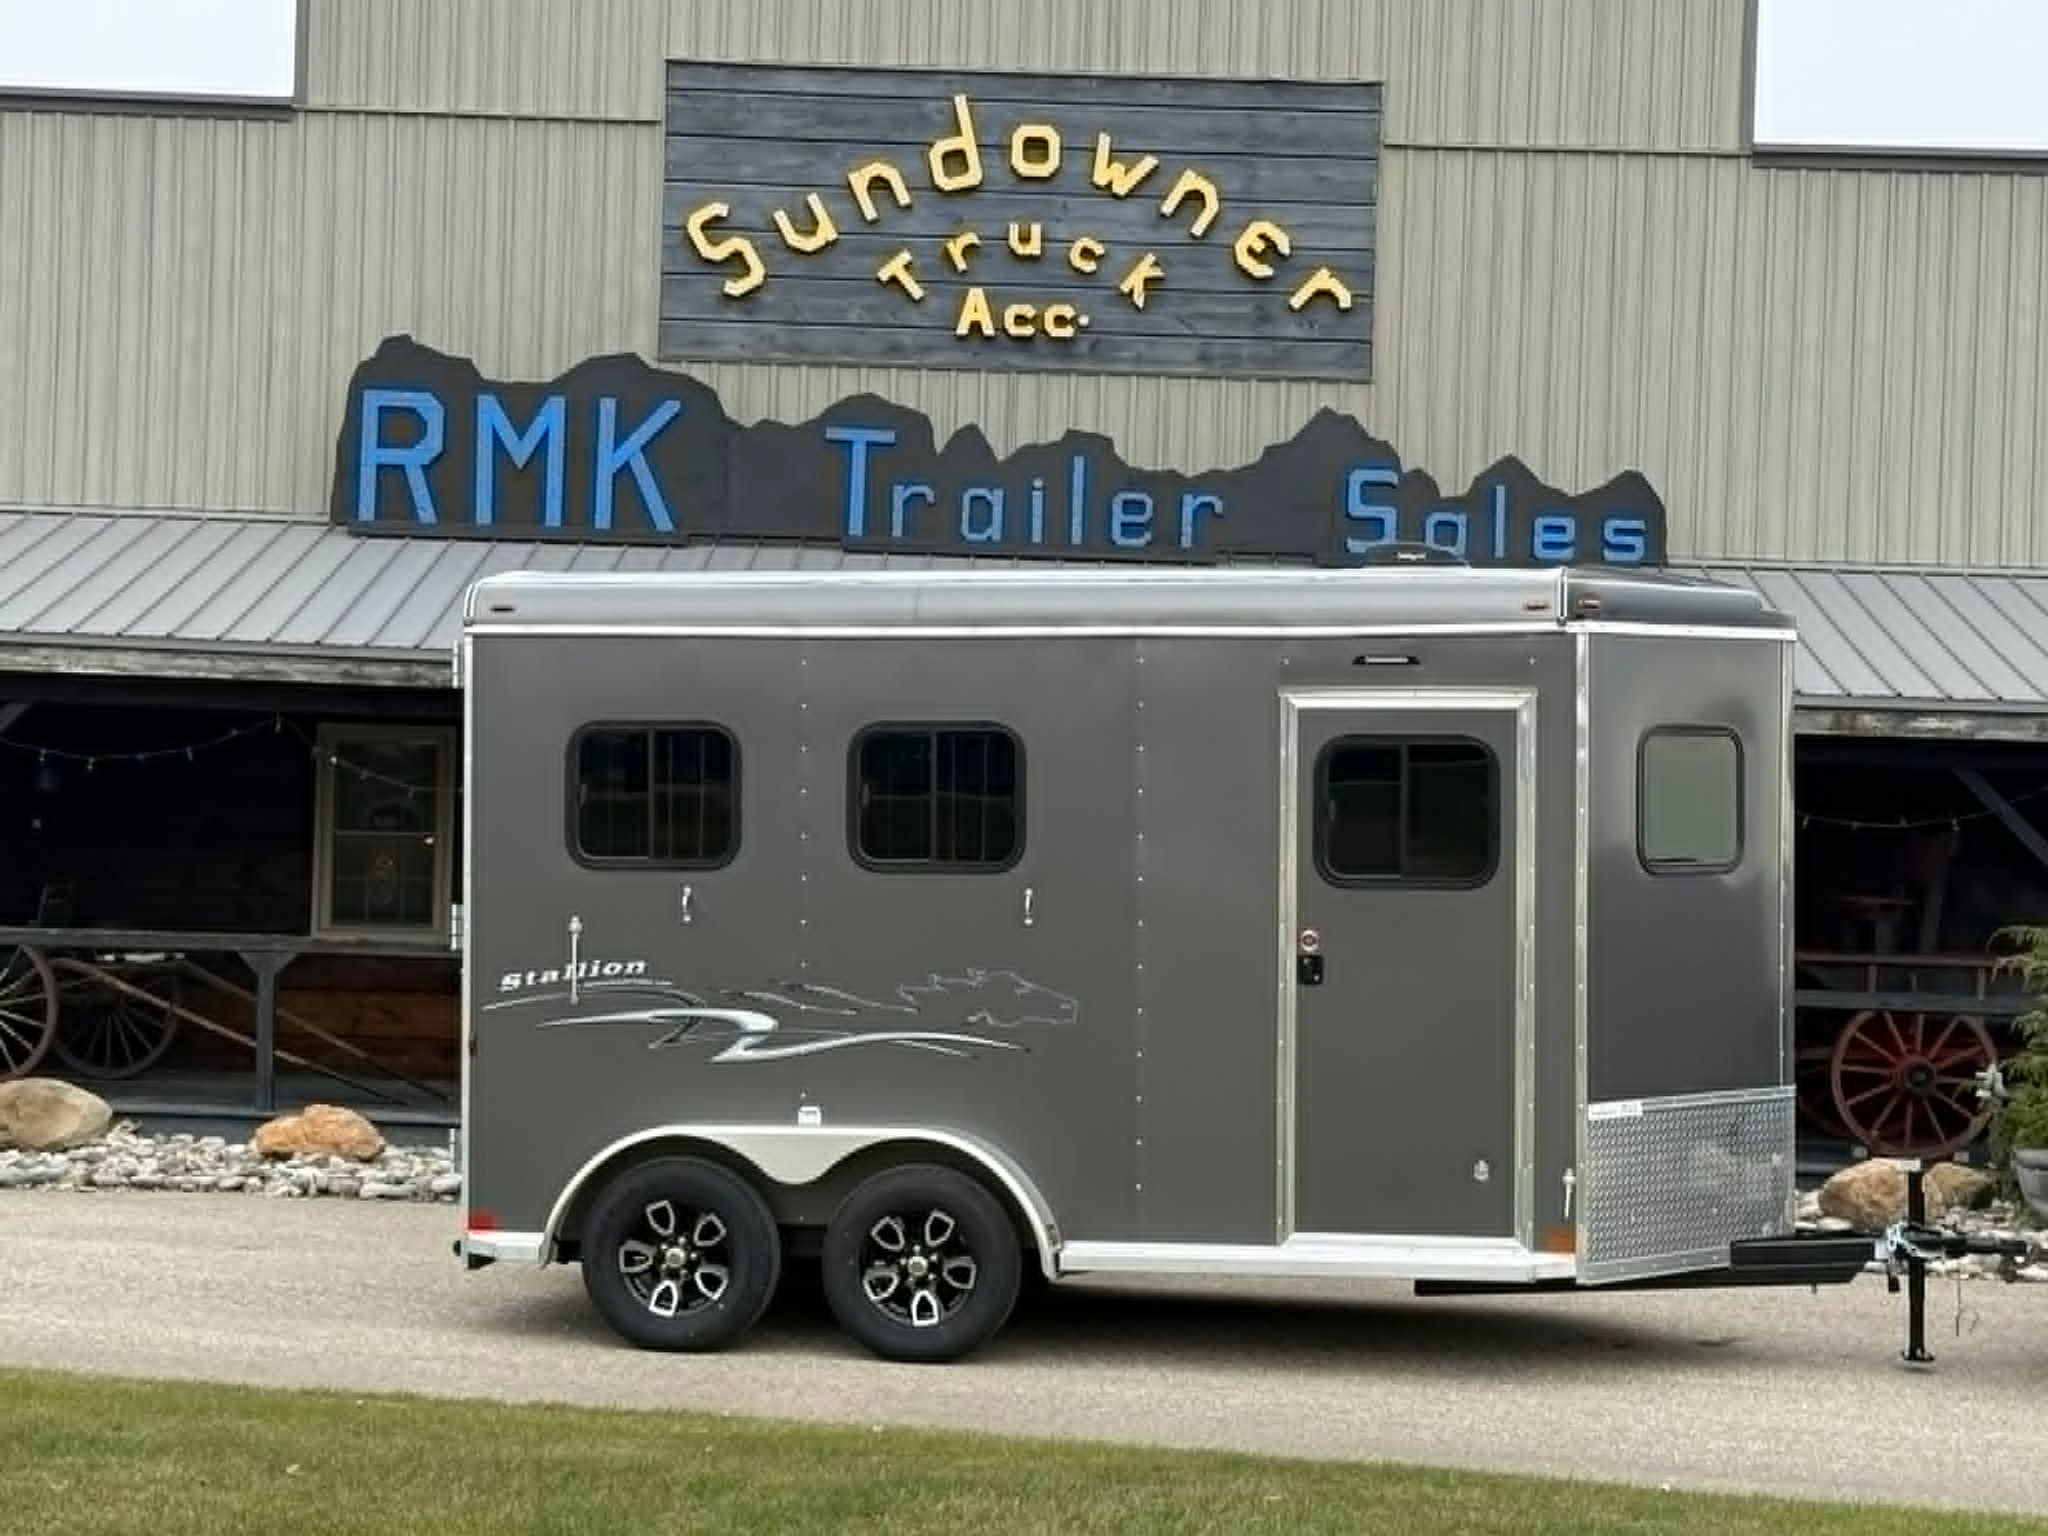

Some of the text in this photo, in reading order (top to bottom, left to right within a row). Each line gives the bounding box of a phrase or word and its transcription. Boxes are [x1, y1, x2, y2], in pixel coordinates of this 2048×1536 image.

[686, 92, 1354, 311] Sundowner
[876, 221, 1166, 312] Truck
[356, 387, 1646, 563] RMK Trailer Sales
